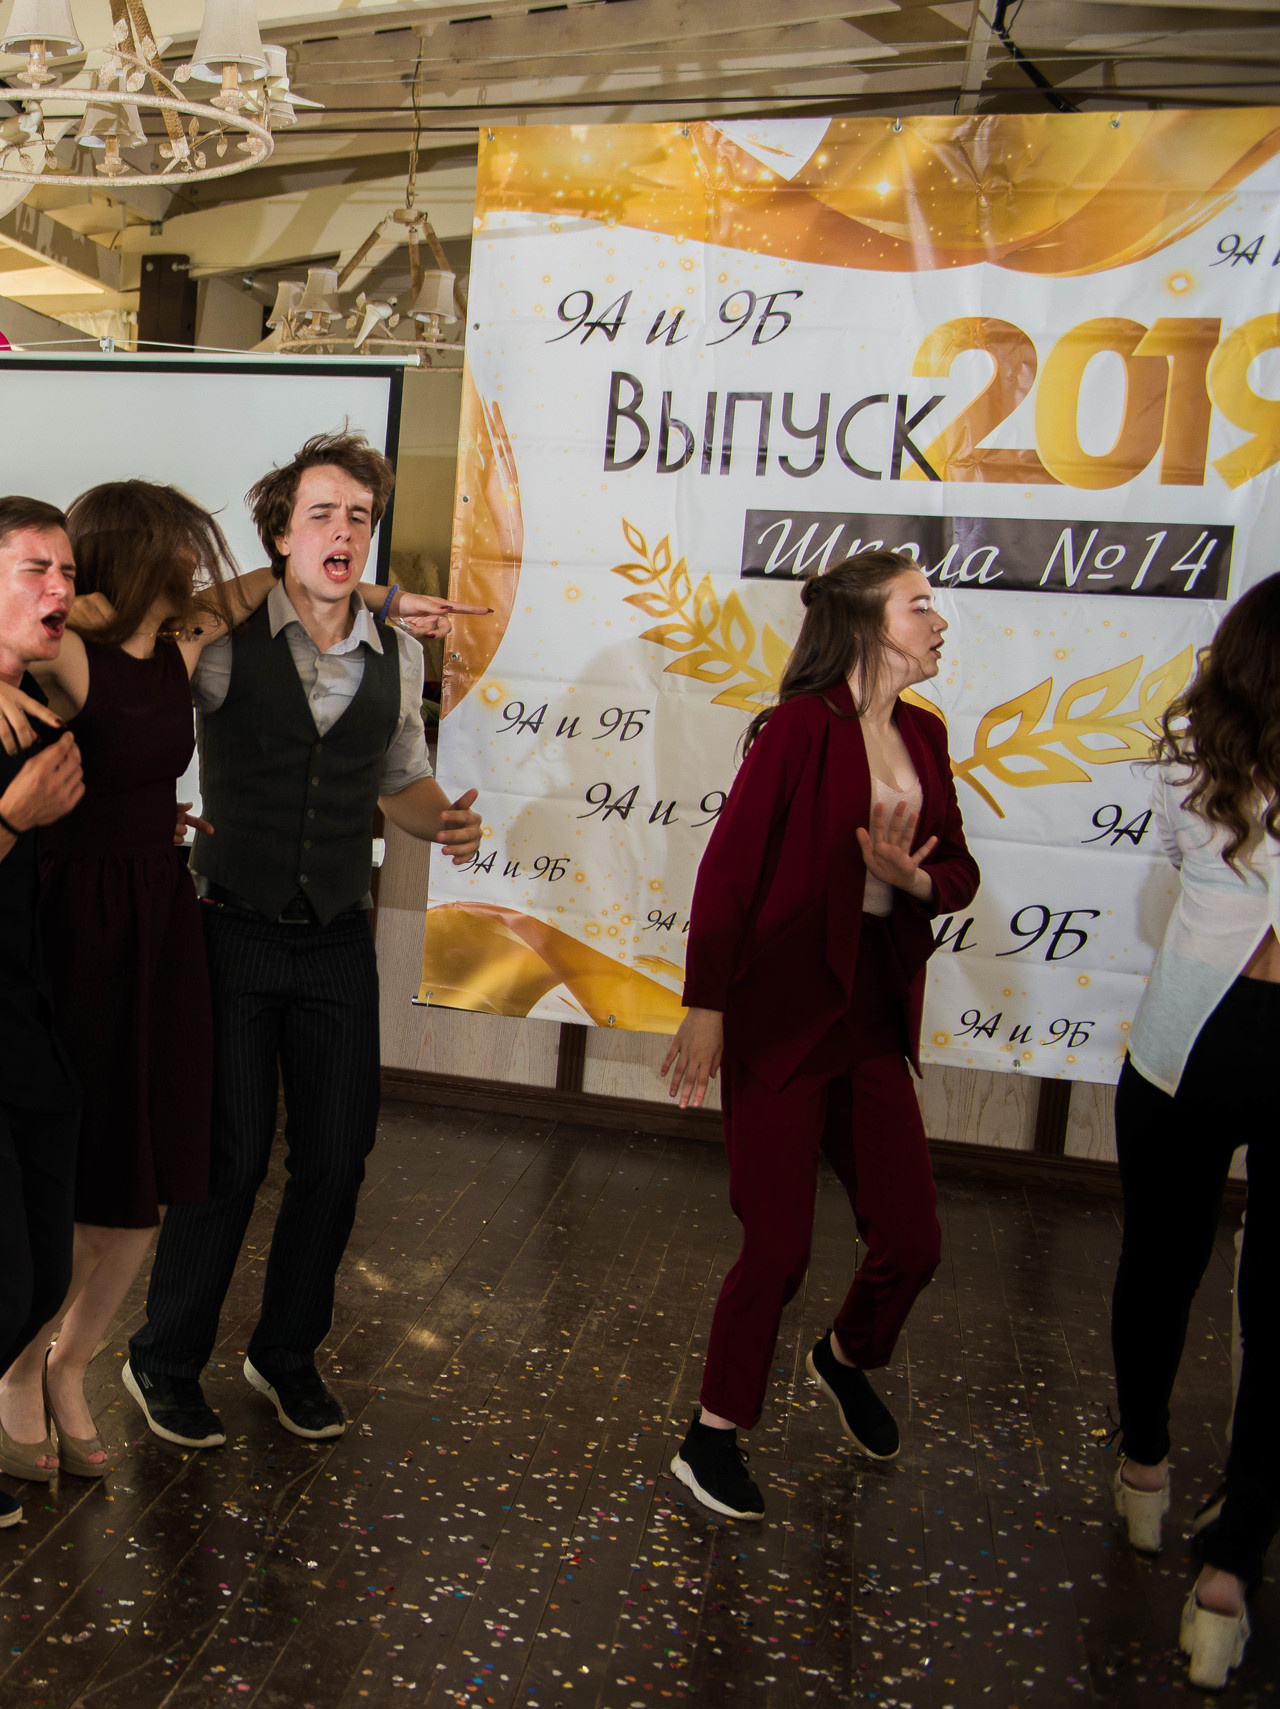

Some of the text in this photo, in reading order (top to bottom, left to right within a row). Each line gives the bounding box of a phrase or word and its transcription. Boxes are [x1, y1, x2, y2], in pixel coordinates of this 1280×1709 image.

[545, 289, 805, 347] 9А и 9Б
[496, 701, 650, 742] 9А и 9Б
[576, 782, 728, 828] 9А и 9
[1081, 804, 1153, 846] 9А
[503, 860, 521, 878] и
[528, 856, 571, 882] 9Б
[642, 909, 678, 932] 9А
[995, 904, 1102, 962] 9Б
[953, 1009, 1096, 1048] 9А и 9Б
